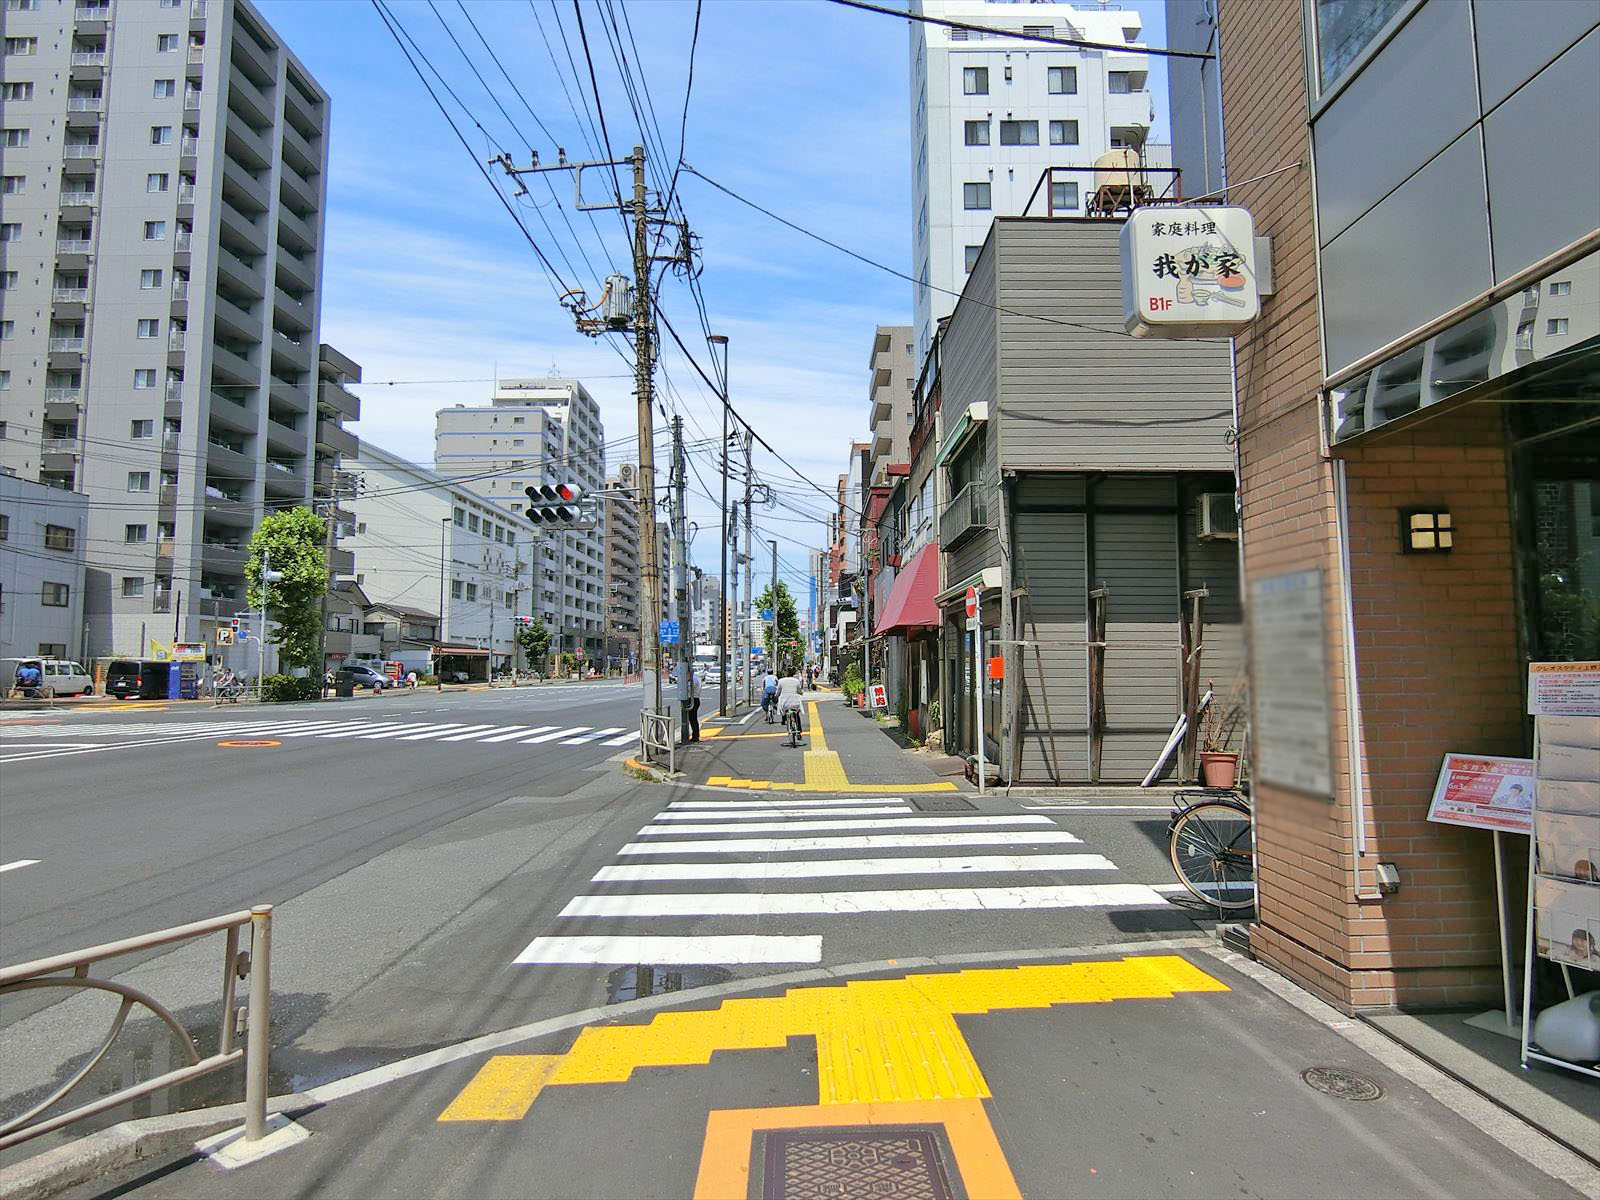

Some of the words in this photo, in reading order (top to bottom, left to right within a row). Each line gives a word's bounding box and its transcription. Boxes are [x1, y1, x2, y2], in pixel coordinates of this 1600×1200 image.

[1152, 221, 1217, 237] 家庭料理
[1152, 252, 1241, 279] 我が家
[1150, 297, 1173, 311] B1F
[221, 630, 230, 641] P
[874, 687, 886, 705] 焼肉
